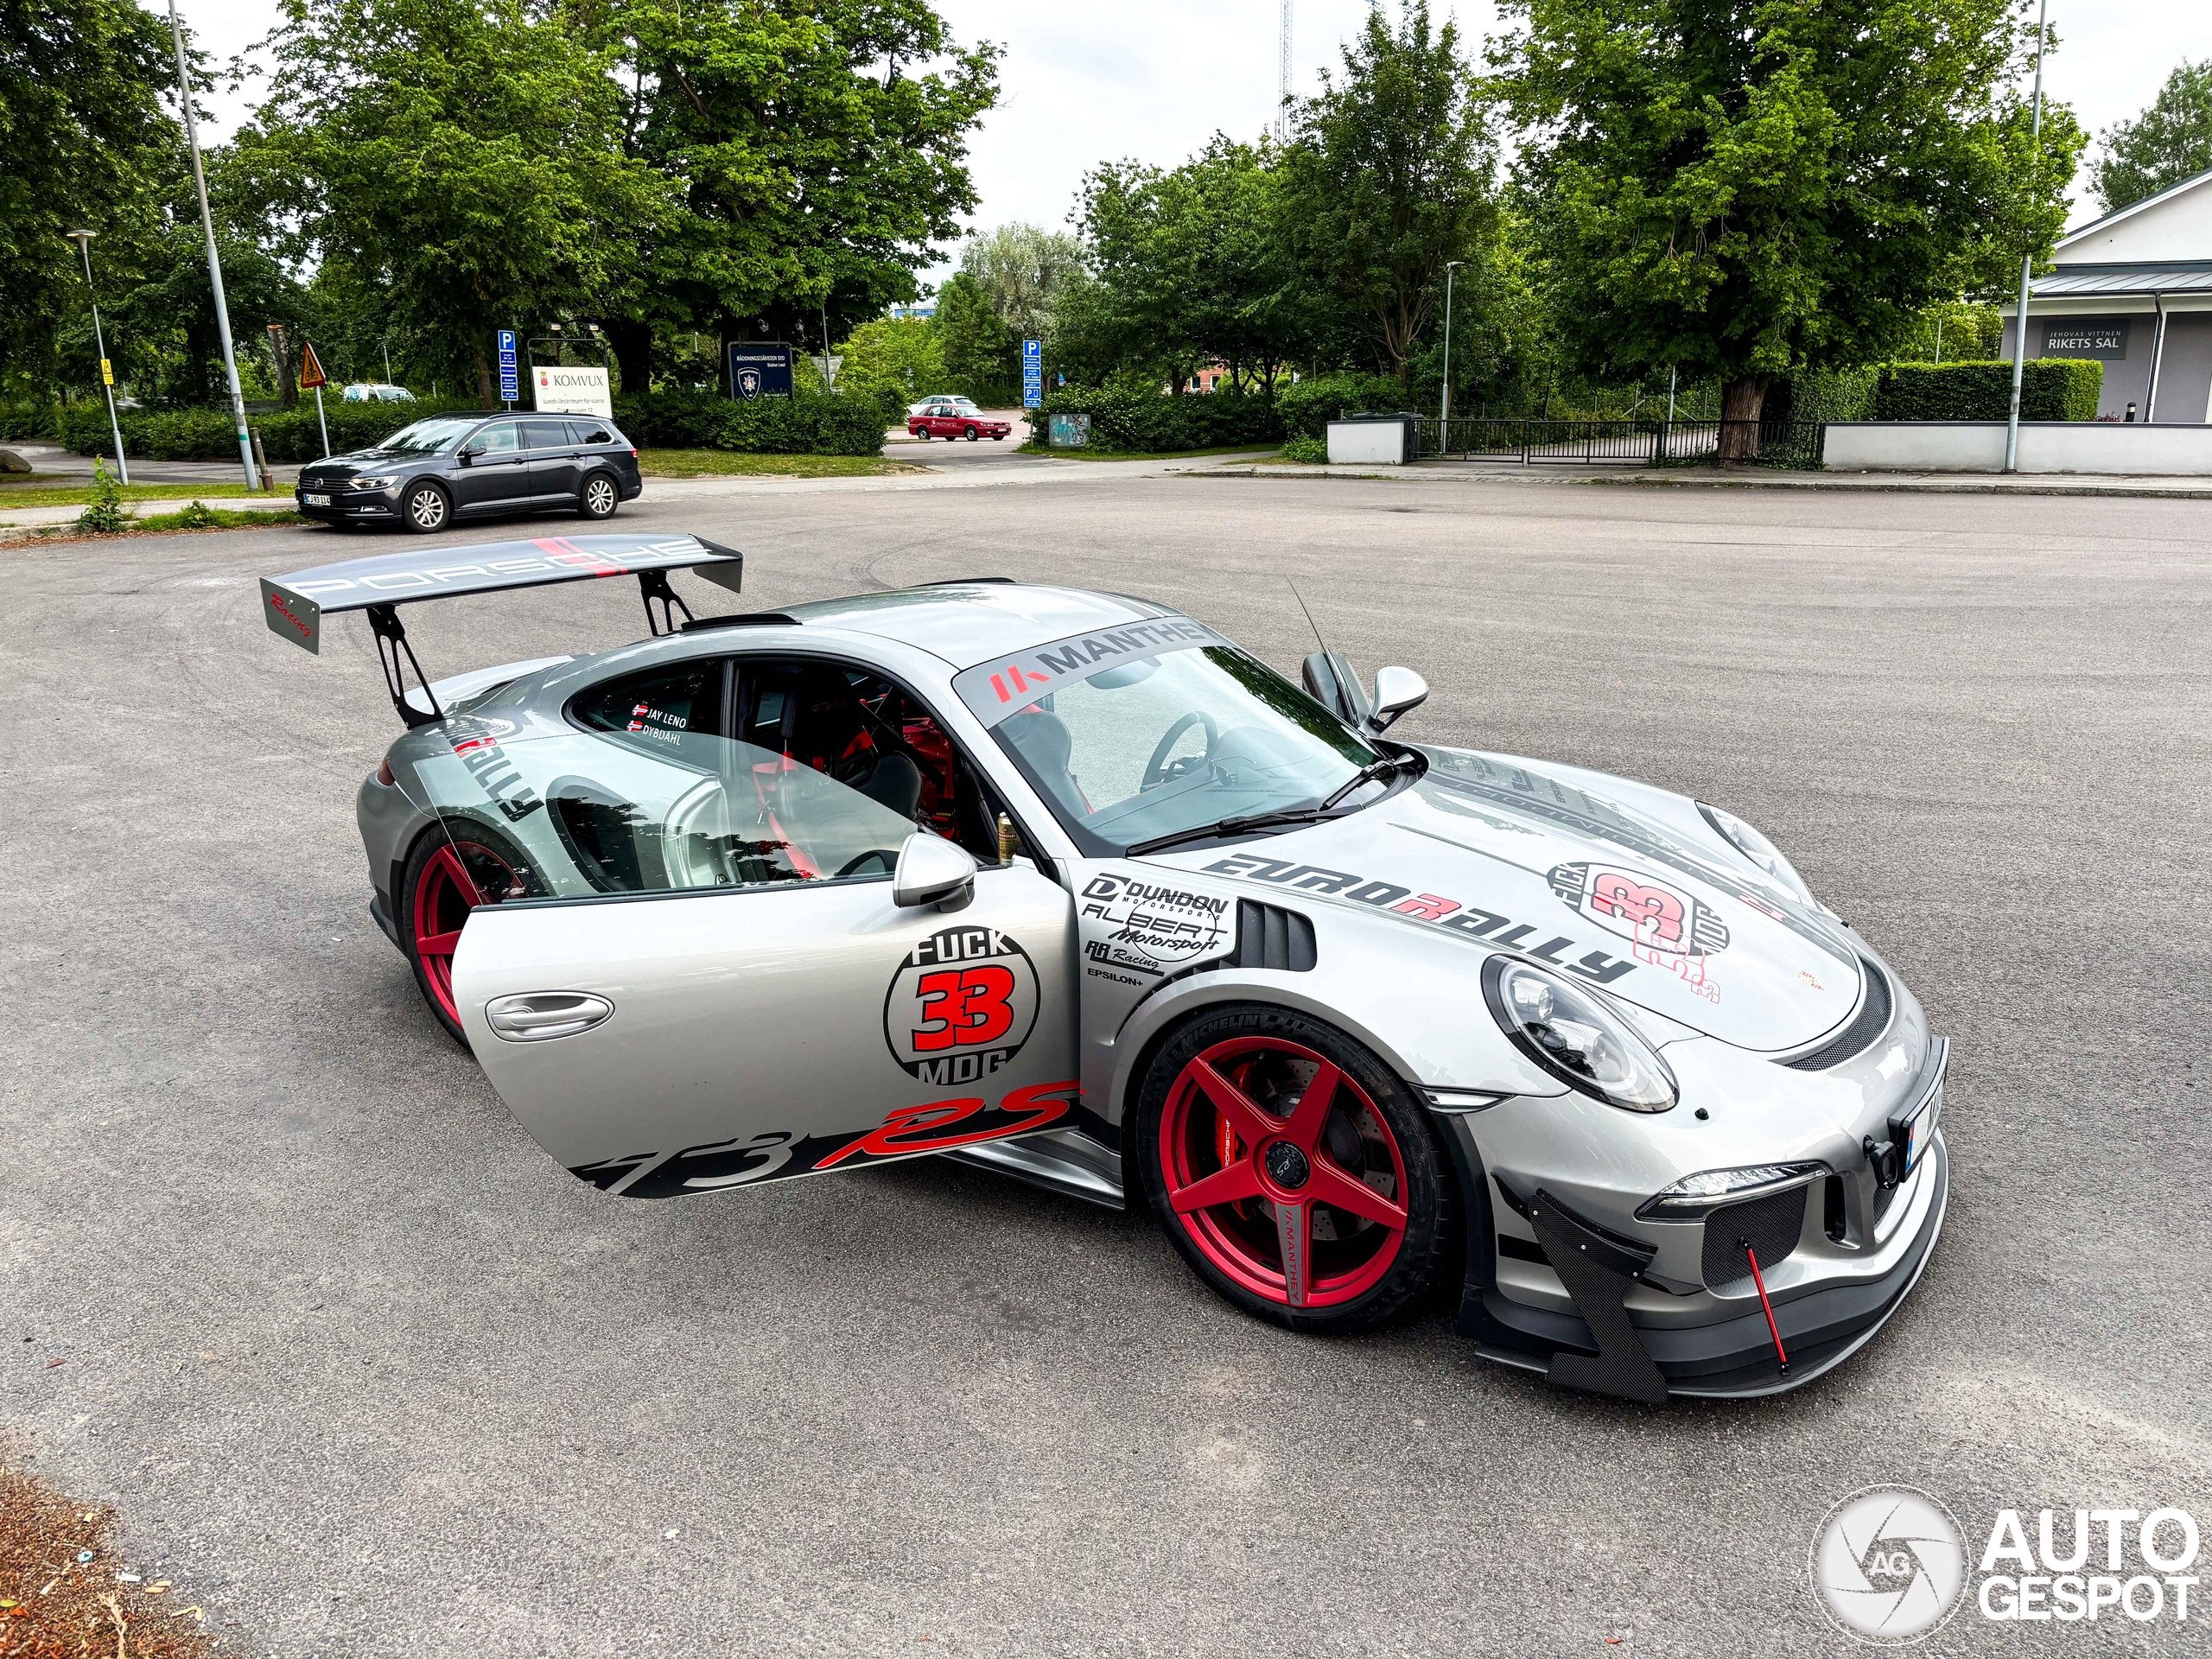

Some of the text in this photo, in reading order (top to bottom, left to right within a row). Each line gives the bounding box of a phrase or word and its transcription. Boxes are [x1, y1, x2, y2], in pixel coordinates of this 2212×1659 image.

[503, 333, 512, 349] P
[1028, 342, 1037, 355] P
[2048, 338, 2120, 349] RIKETS SAL
[554, 375, 603, 387] KOMVUX
[283, 538, 713, 599] PORSCHE
[270, 593, 312, 638] Racing
[1035, 621, 1219, 676] MANTHEY
[646, 709, 686, 728] JAY LENO
[642, 725, 681, 746] DYBDAHL
[1122, 897, 1221, 920] MOTORSPORTS
[1126, 881, 1229, 914] DUNDON
[1590, 873, 1686, 944] 33
[1082, 903, 1229, 938] ALBERT
[912, 930, 1013, 965] FUCK
[1108, 927, 1220, 951] Motorsport
[1113, 948, 1160, 970] Racing
[1088, 968, 1143, 987] EPSILON+
[912, 964, 1015, 1052] 33
[1181, 1013, 1261, 1052] MICHELIN
[918, 1050, 1007, 1085] MDG
[1287, 1226, 1300, 1302] MANTHEY
